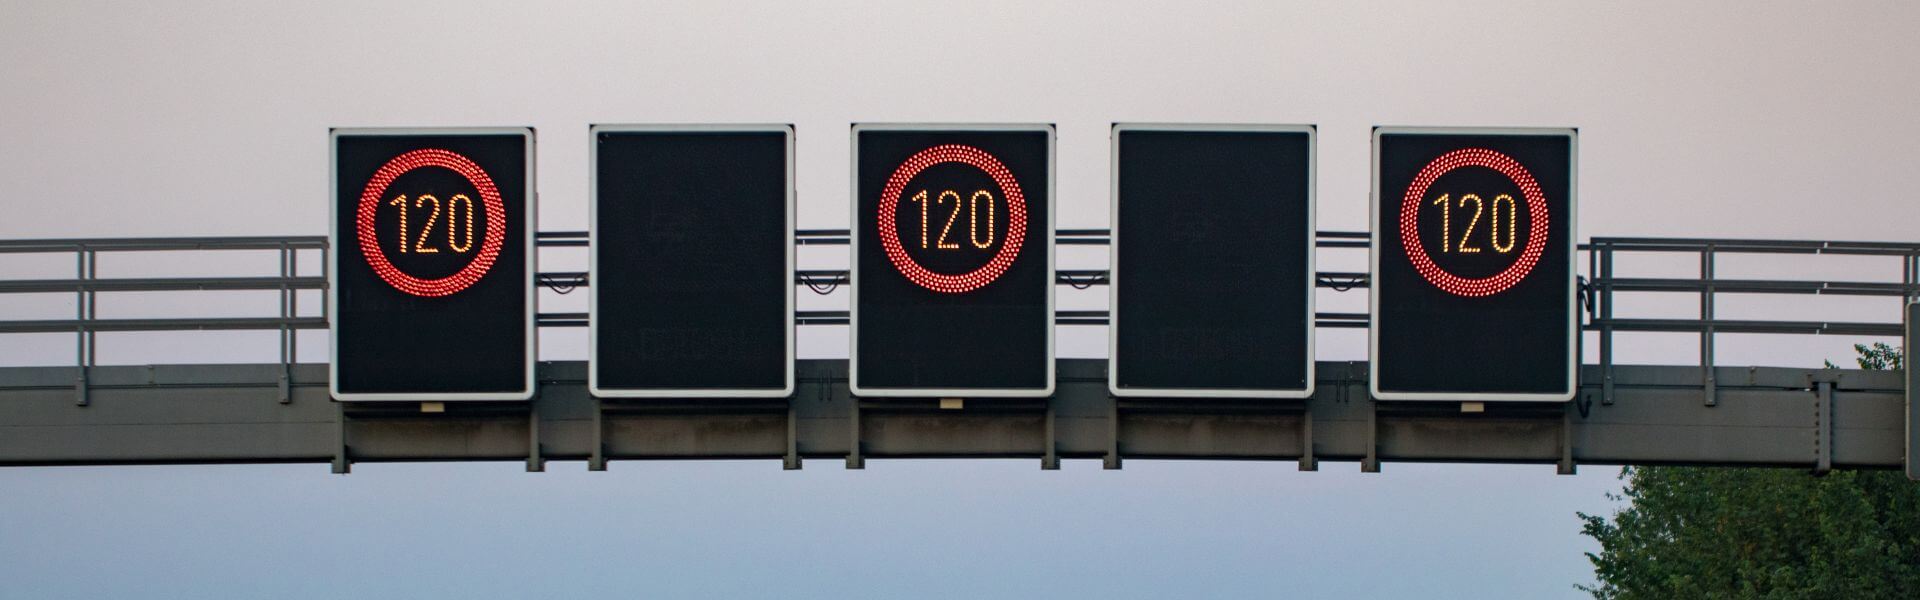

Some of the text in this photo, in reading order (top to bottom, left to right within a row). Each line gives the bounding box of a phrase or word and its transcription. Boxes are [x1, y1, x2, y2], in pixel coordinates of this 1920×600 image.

[389, 193, 473, 253] 120
[911, 190, 994, 249] 120
[1433, 193, 1516, 253] 120
